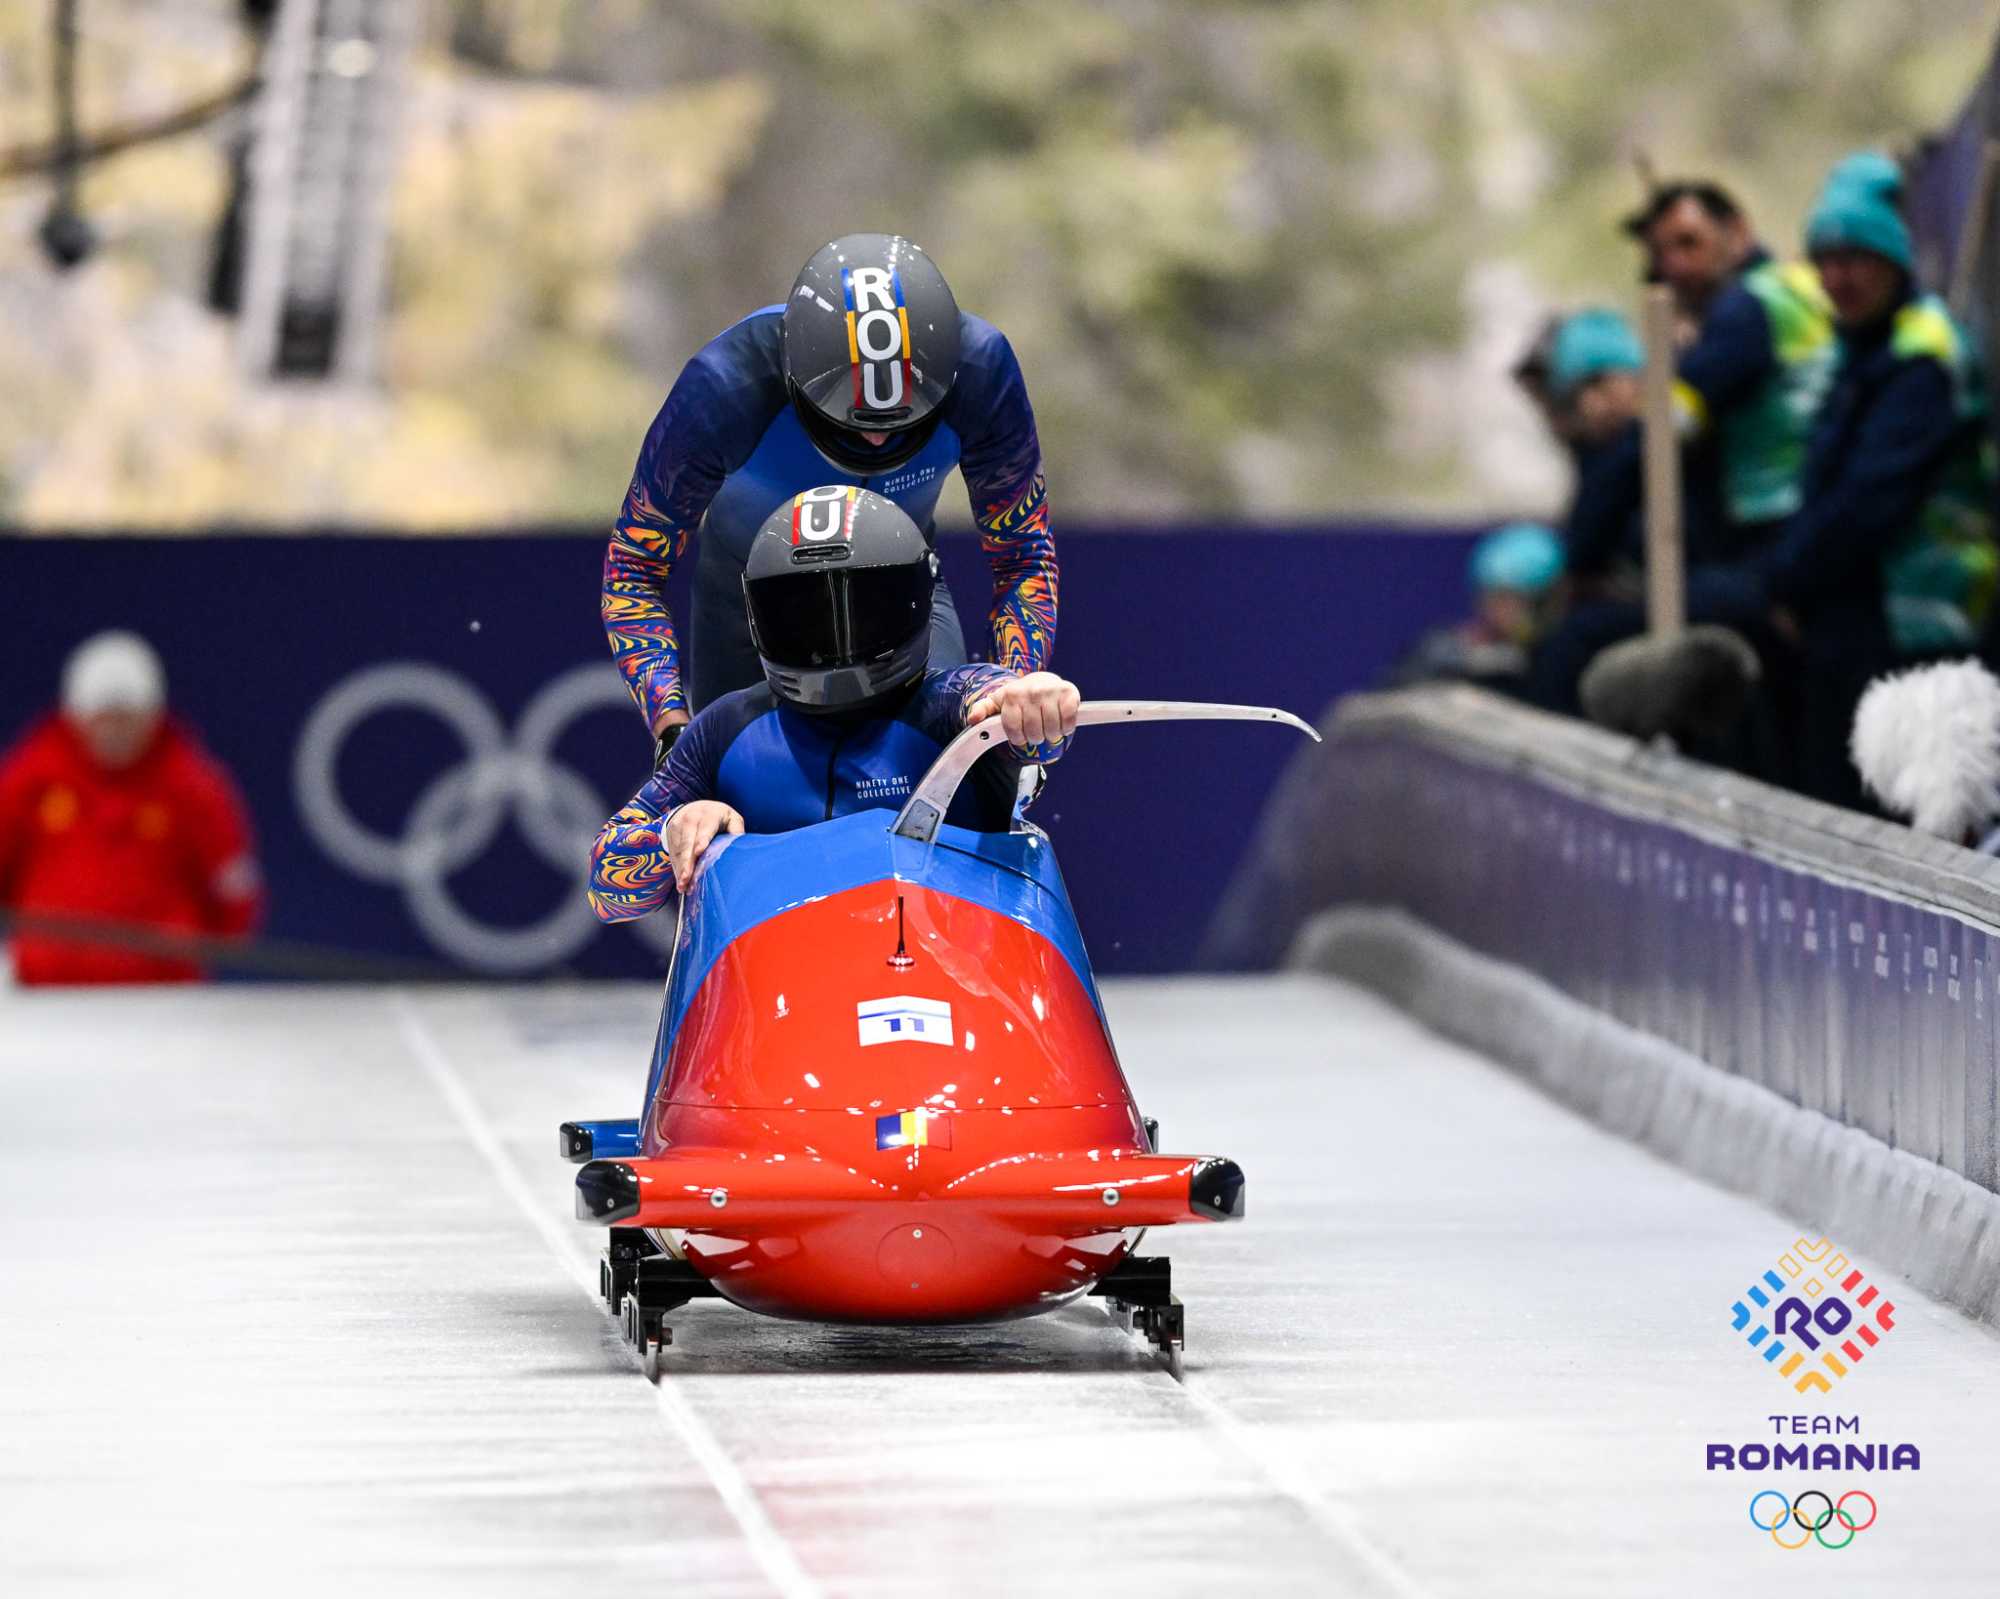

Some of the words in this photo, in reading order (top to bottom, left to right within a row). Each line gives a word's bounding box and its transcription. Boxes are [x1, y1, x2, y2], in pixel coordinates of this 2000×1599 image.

[853, 267, 903, 409] ROU
[884, 474, 916, 487] NINETY
[856, 778, 887, 789] NINETY
[892, 776, 909, 785] ONE
[857, 786, 911, 799] COLLECTIVE
[883, 1018, 925, 1032] 11
